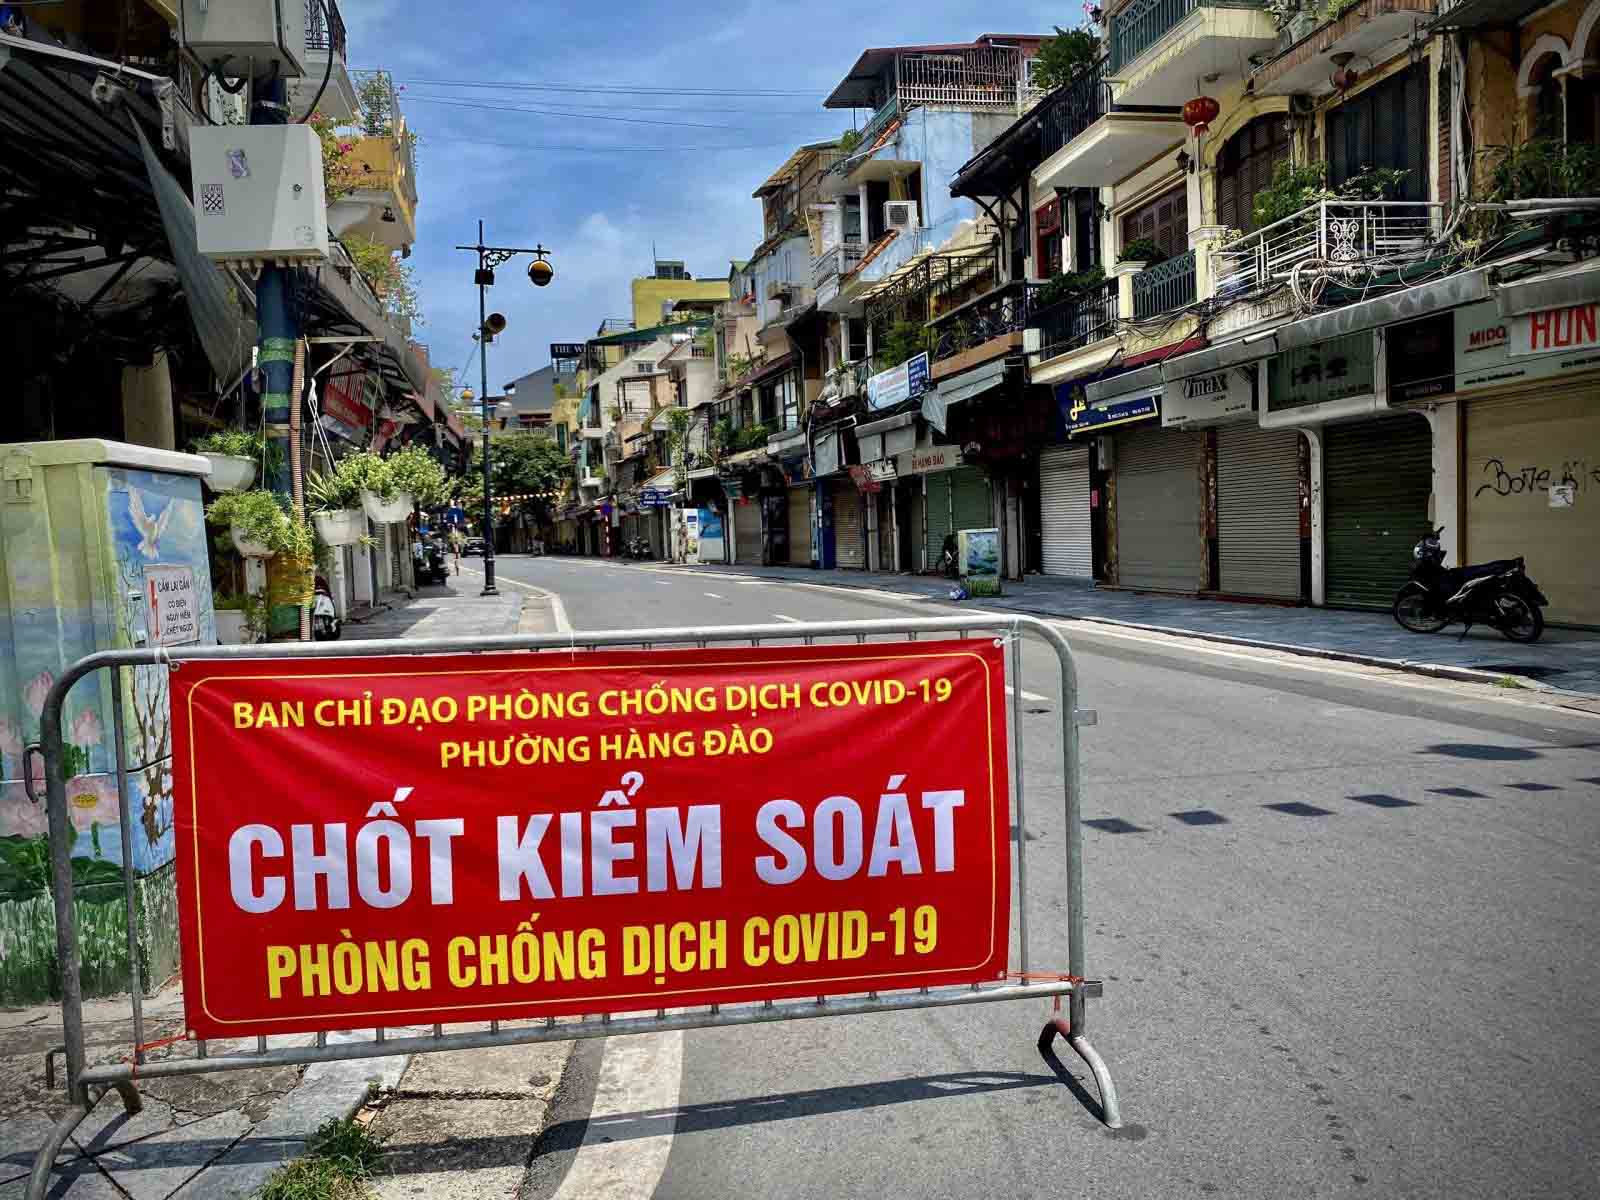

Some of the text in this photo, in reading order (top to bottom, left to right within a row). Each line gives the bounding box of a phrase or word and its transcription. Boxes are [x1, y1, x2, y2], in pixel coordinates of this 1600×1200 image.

[1470, 325, 1506, 345] MIDO
[233, 678, 952, 732] BAN CHỈ ĐẠO PHÒNG CHỐNG DỊCH COVID-19
[441, 724, 773, 768] PHƯỜNG HÀNG ĐÀO
[229, 771, 964, 913] CHỐT KIỂM SOÁT
[267, 905, 938, 998] PHÒNG CHỐNG DỊCH COVID-19
